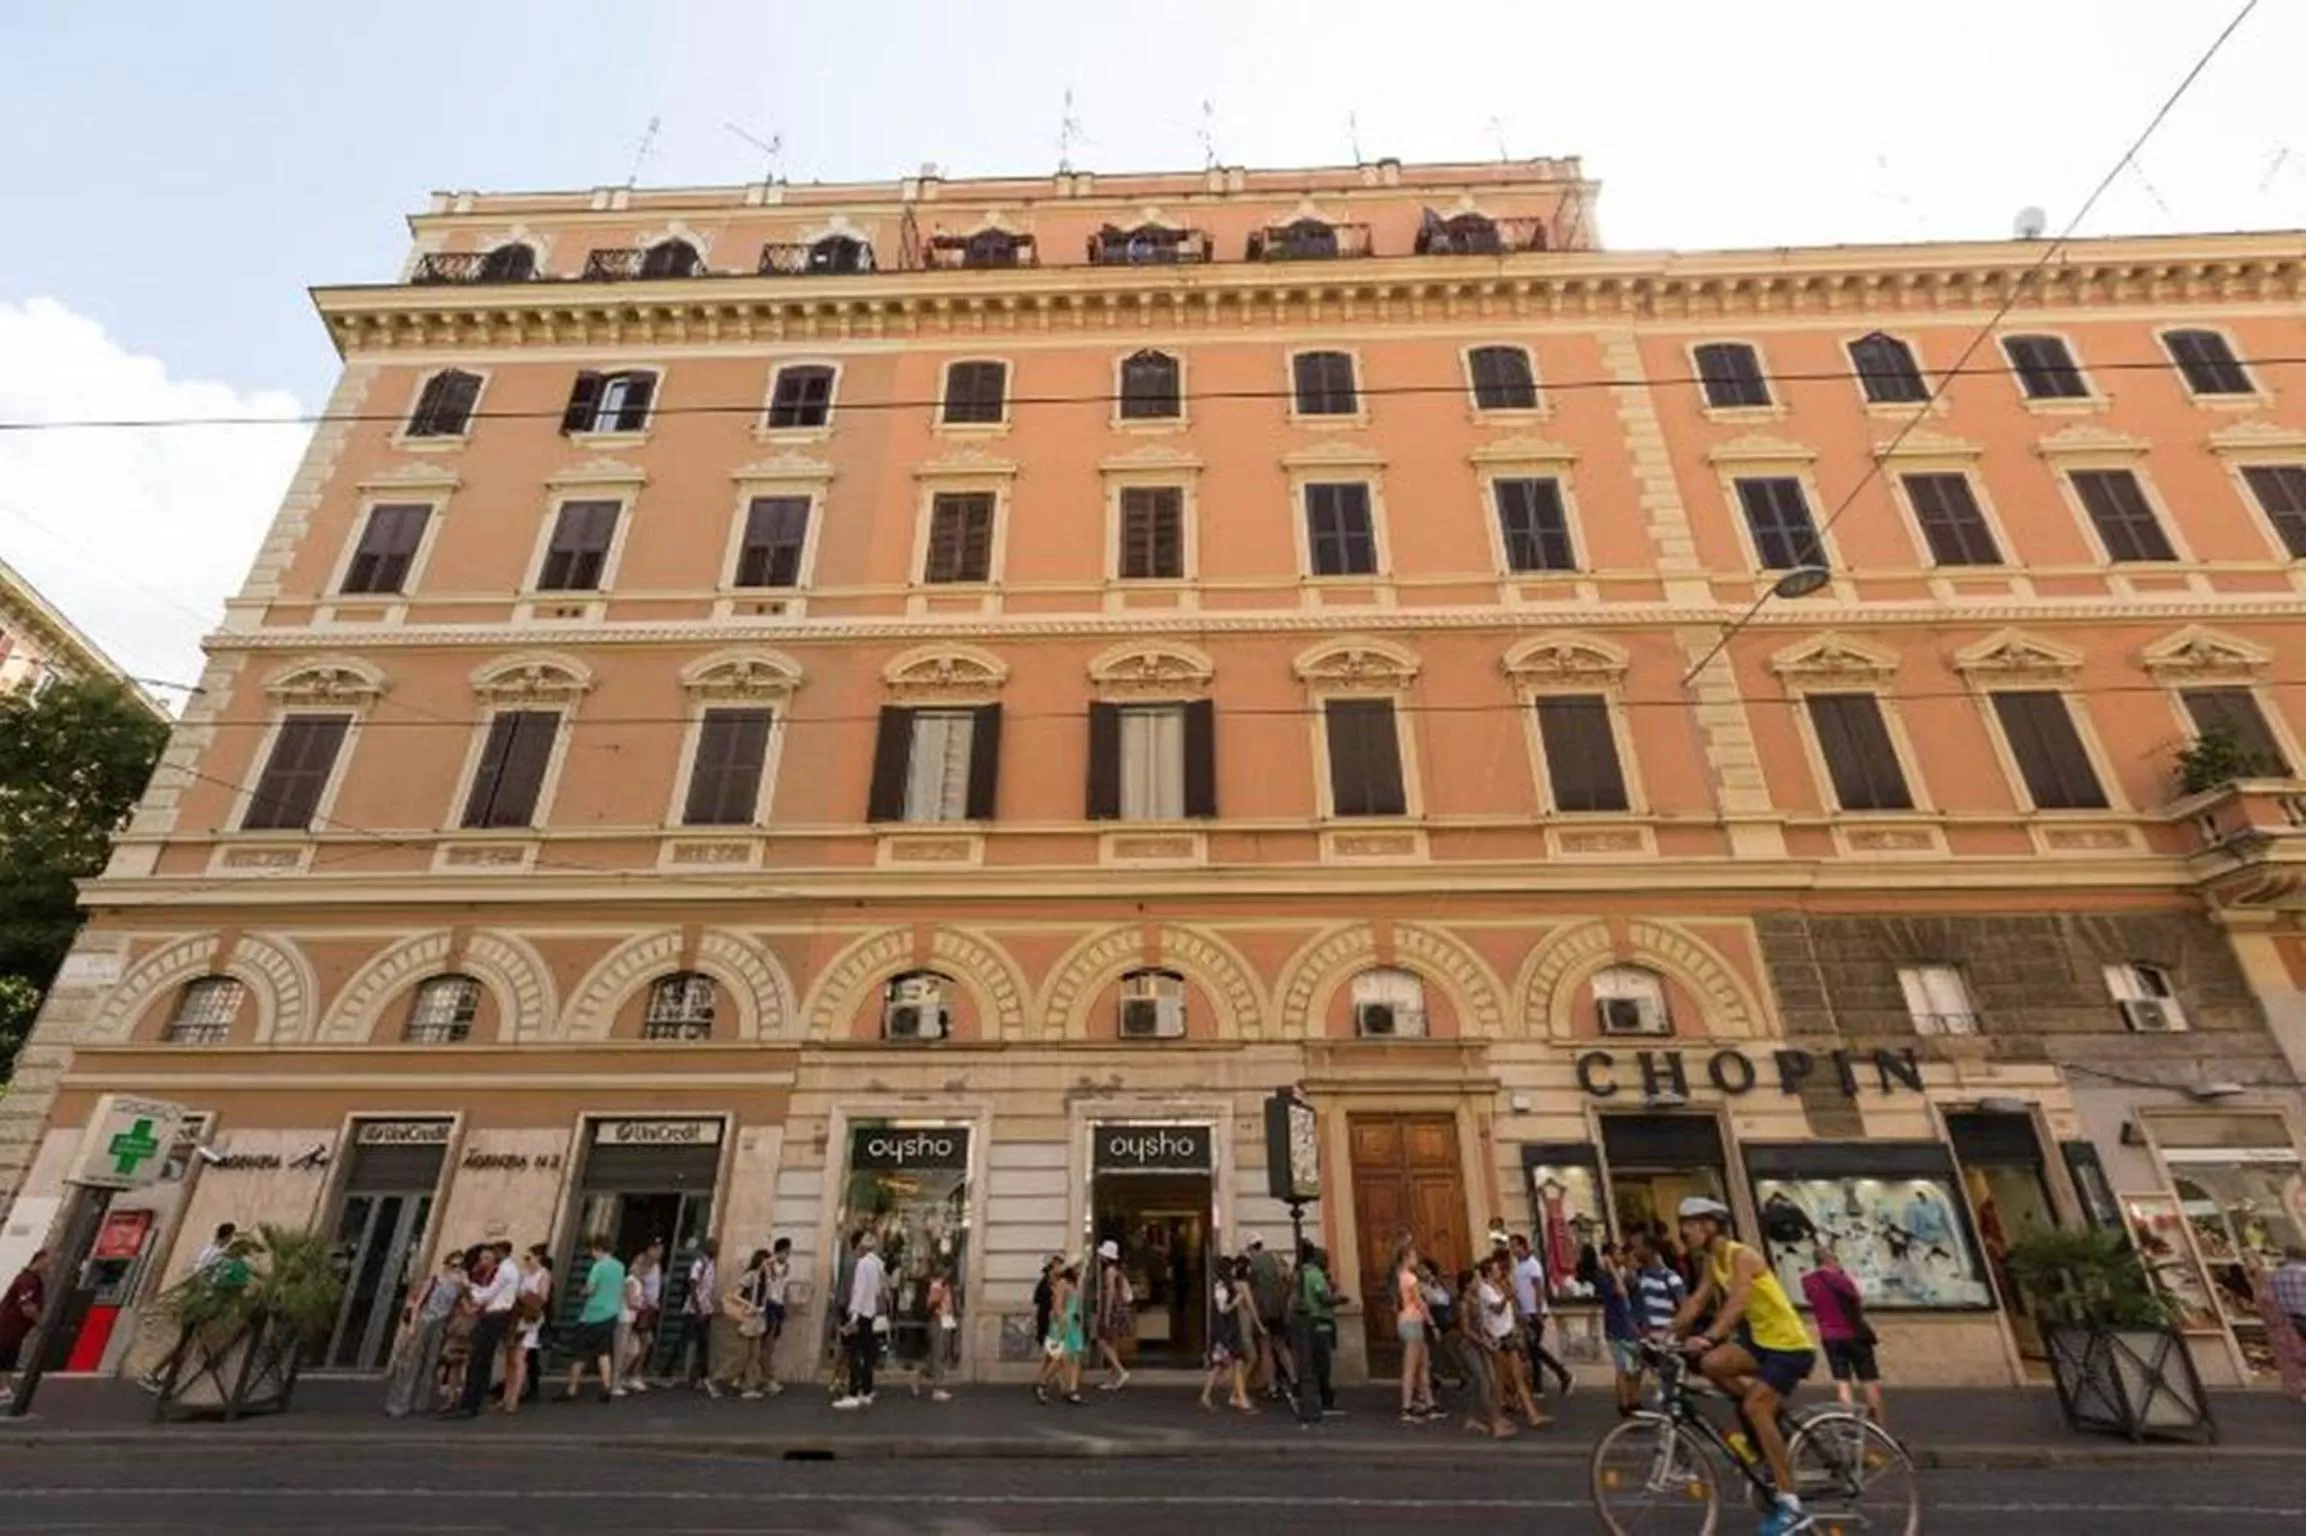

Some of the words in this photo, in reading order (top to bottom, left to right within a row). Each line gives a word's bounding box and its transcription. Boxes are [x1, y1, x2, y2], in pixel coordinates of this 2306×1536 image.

[1577, 1049, 1925, 1097] CHOPIN
[635, 1121, 701, 1141] UniCredit
[1110, 1130, 1195, 1164] oysho
[868, 1132, 953, 1164] oysho
